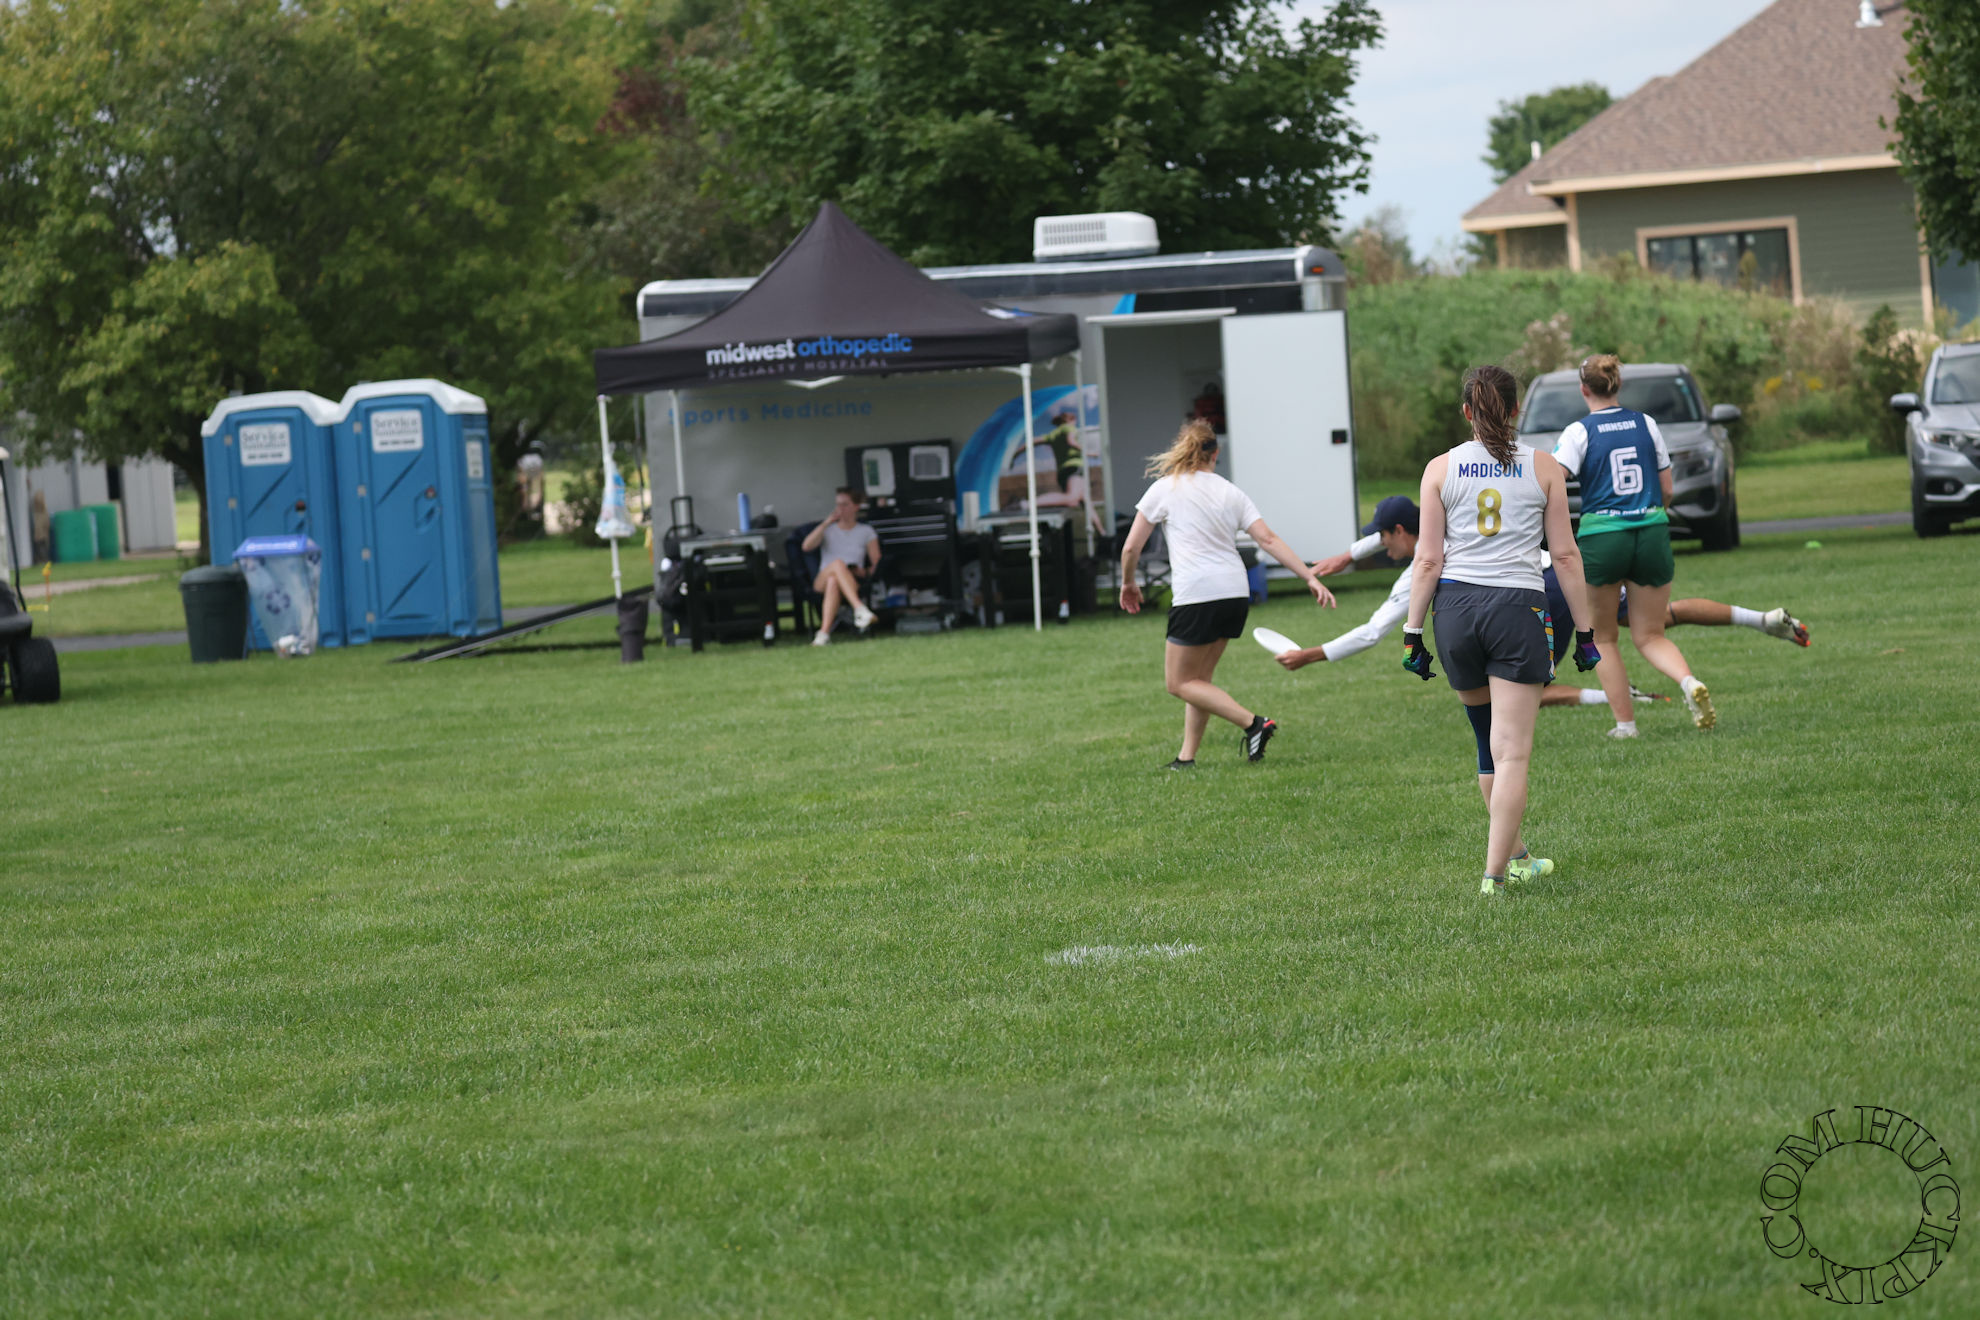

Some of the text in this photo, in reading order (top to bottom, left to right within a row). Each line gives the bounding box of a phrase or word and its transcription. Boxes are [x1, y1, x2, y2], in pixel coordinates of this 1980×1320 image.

[706, 333, 913, 366] midwest orthopedic
[708, 358, 888, 379] SPECIALTY HOSPITAL
[761, 399, 873, 420] Medicine
[1458, 463, 1523, 478] MADISON
[1609, 446, 1643, 496] 6
[1477, 488, 1502, 537] 8
